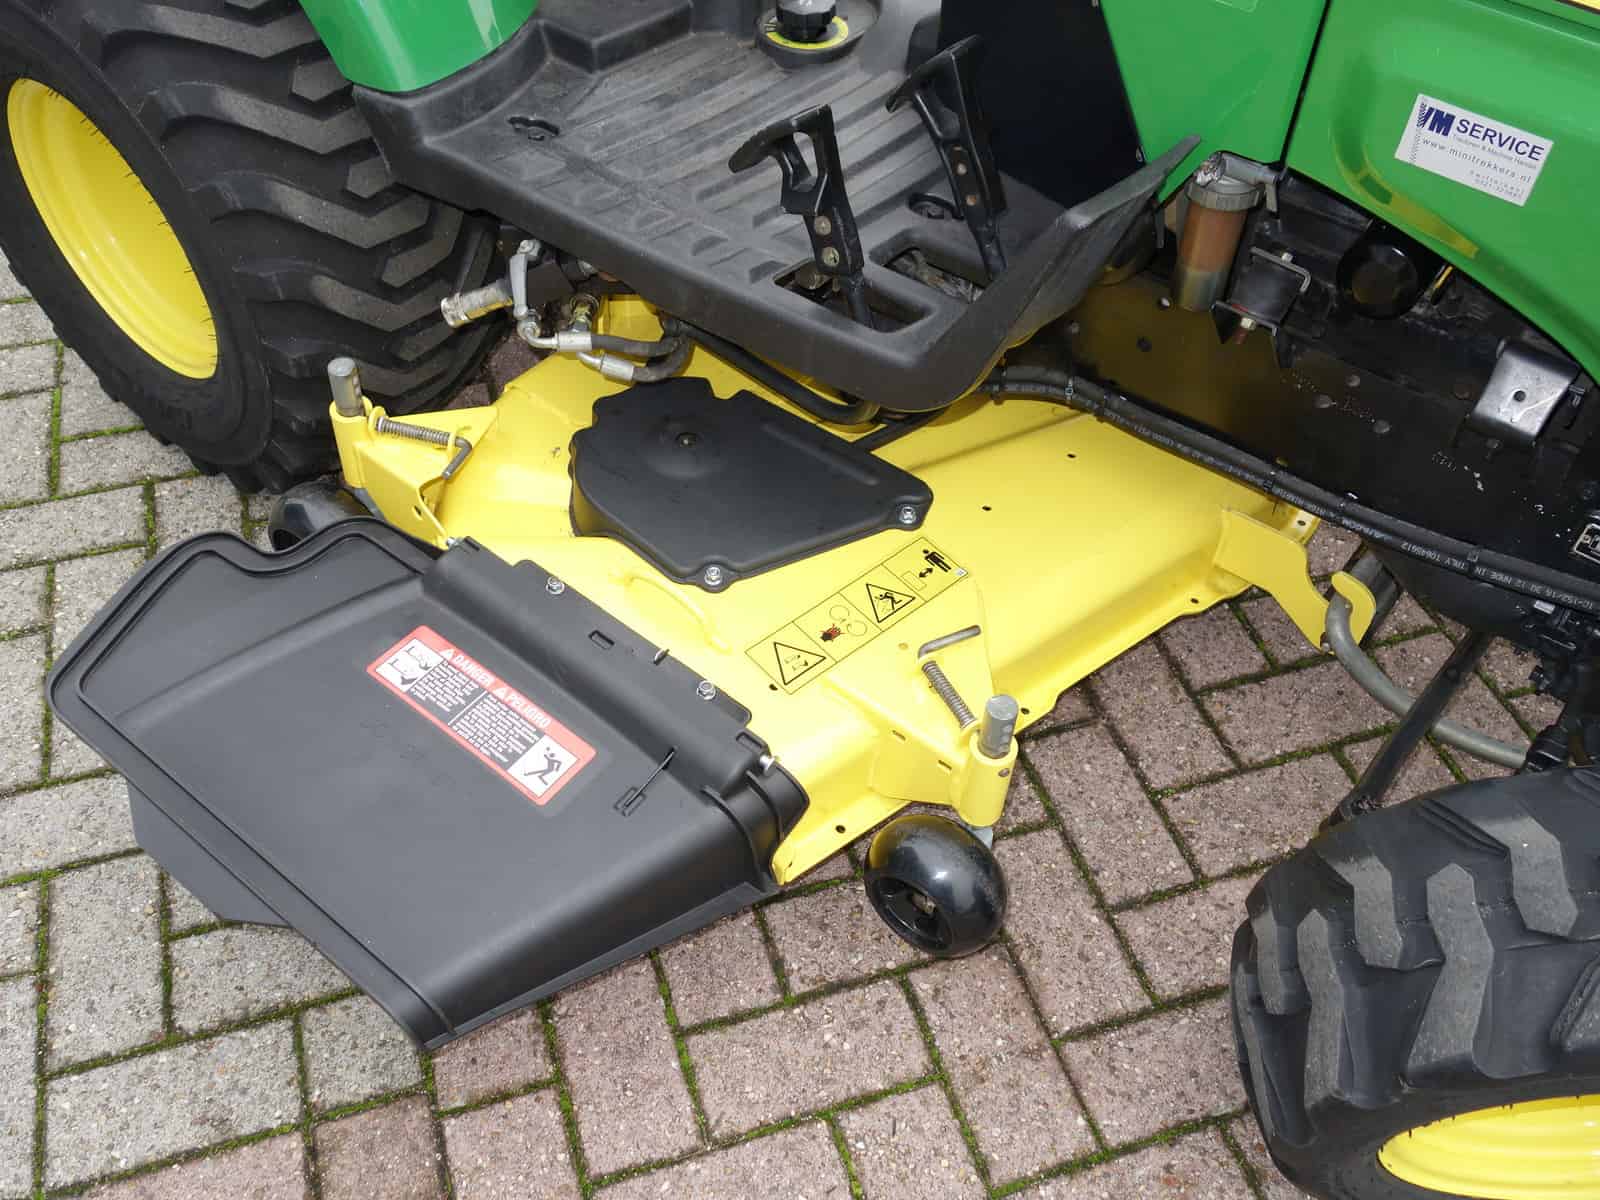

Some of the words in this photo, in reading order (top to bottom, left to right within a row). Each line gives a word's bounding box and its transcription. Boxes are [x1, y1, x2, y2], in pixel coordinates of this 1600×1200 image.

[1456, 118, 1545, 161] SERVICE
[453, 655, 496, 688] DANGER
[506, 694, 552, 729] PELIGRO
